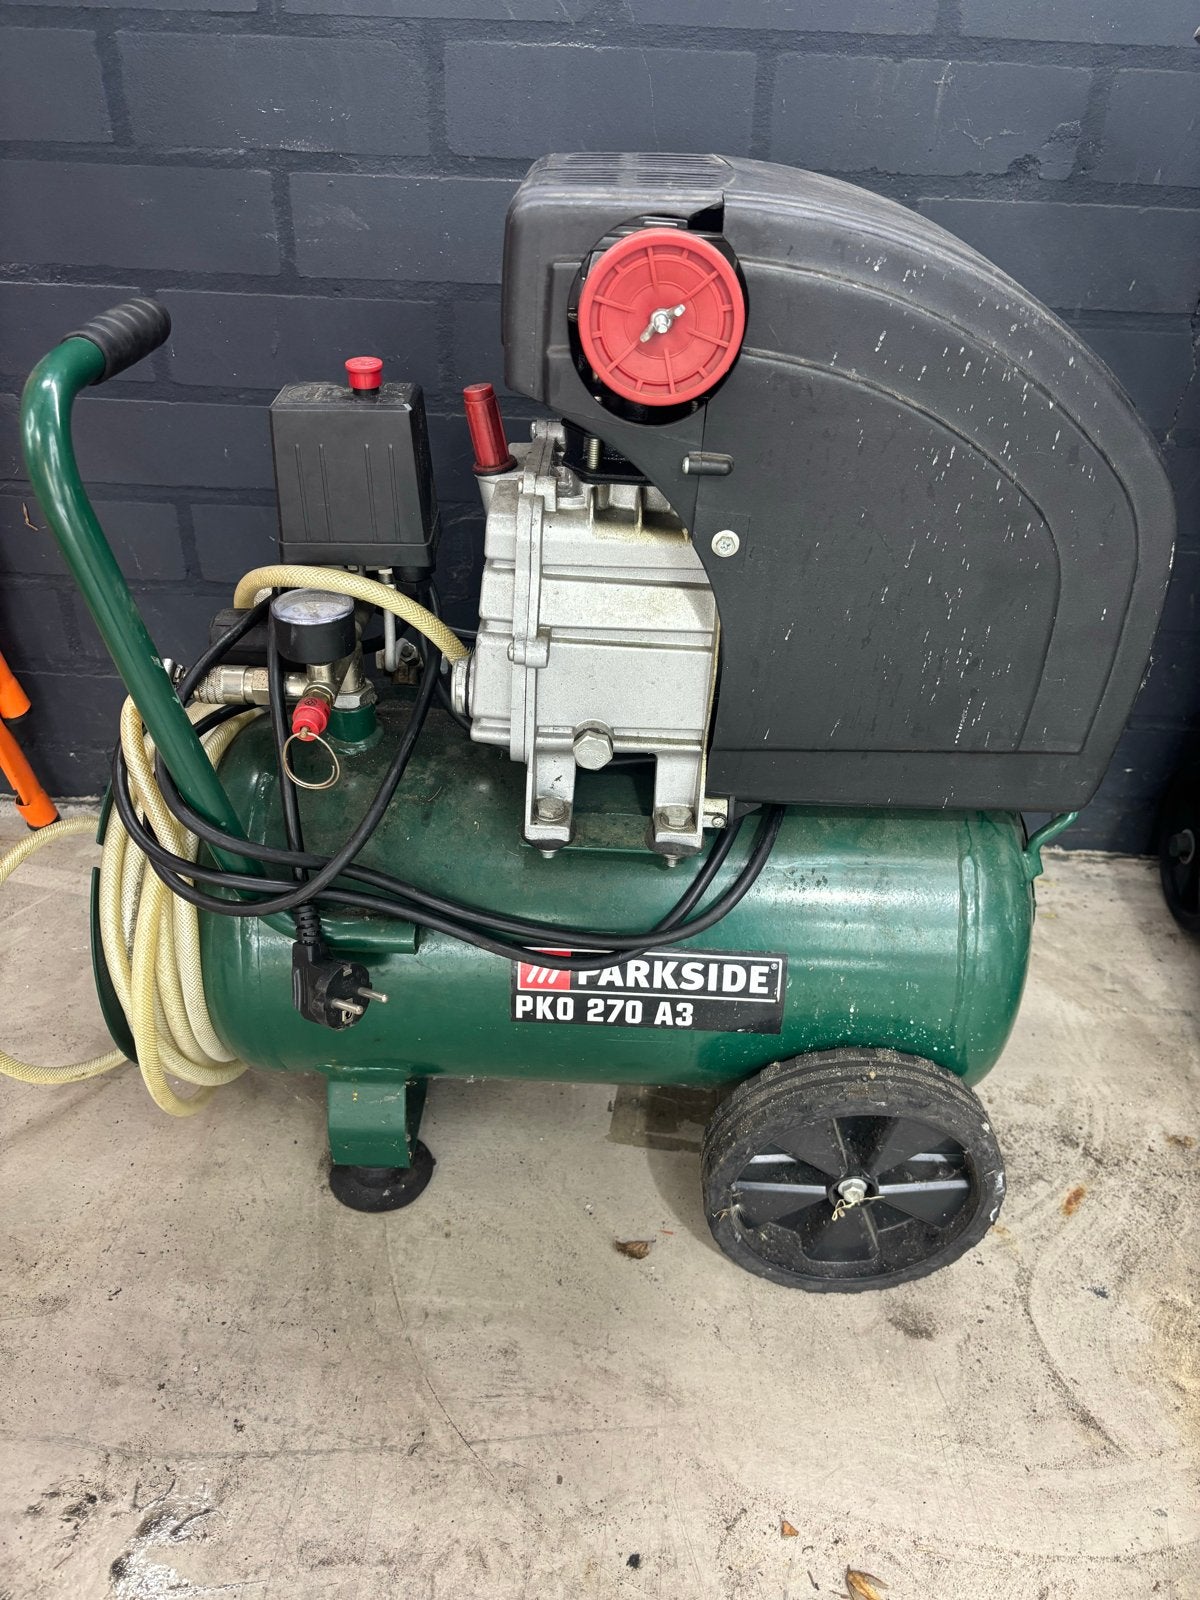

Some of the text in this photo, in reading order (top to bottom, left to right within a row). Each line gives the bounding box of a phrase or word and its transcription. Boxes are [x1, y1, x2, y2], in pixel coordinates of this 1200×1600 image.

[515, 995, 694, 1027] PKO 270 A3
